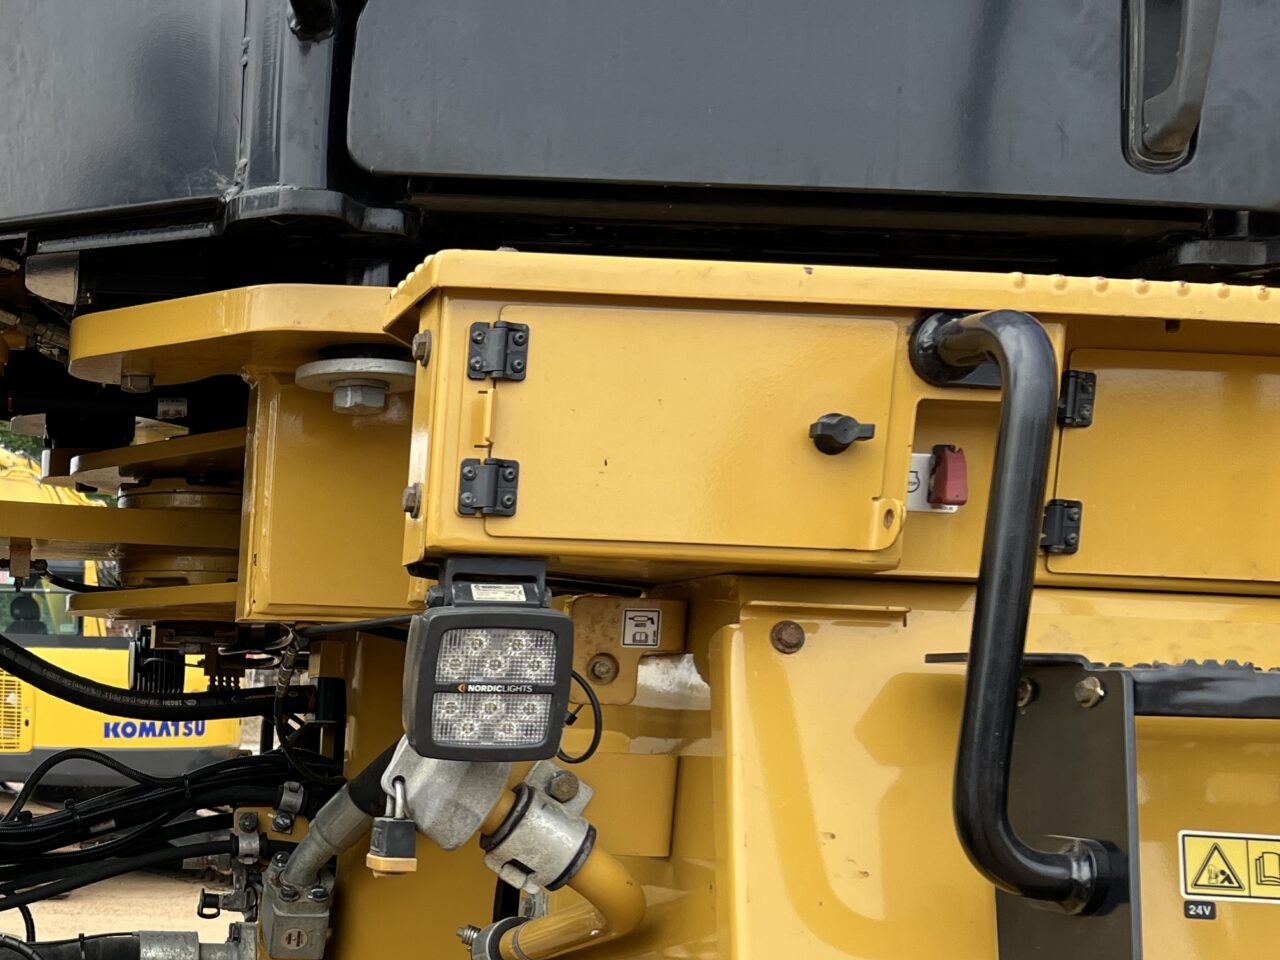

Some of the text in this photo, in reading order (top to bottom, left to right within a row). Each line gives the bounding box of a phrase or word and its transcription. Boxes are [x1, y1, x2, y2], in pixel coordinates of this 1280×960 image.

[468, 684, 532, 693] NORDICLIGHTS
[104, 720, 206, 738] KOMATSU
[1188, 905, 1211, 915] 24V
